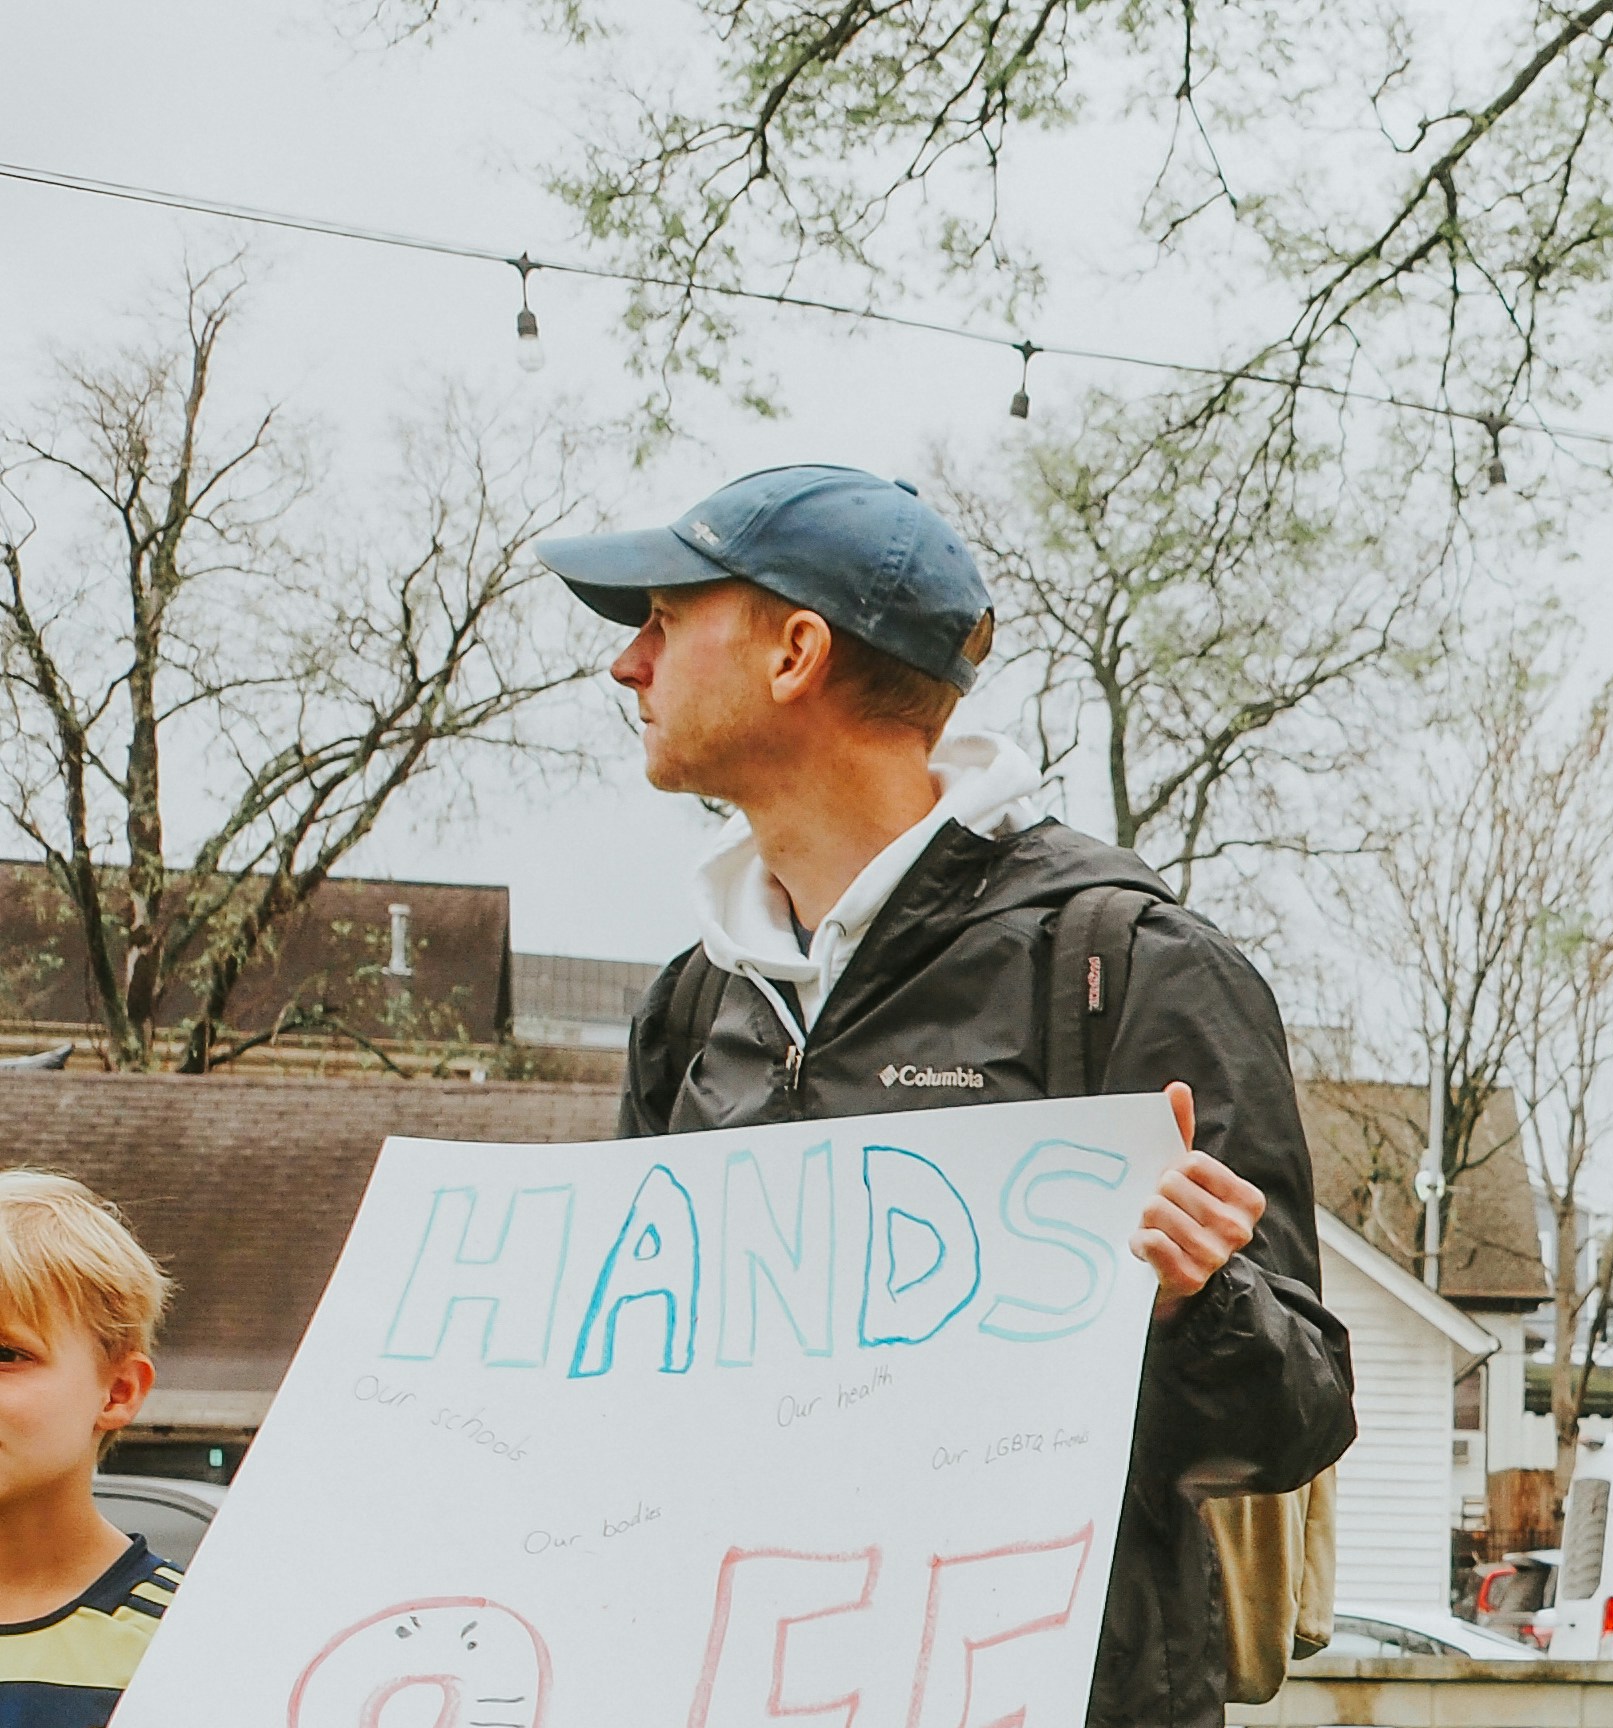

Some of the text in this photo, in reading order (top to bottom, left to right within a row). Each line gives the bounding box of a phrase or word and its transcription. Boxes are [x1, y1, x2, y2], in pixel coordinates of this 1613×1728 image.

[898, 1065, 984, 1088] Columbia
[383, 1138, 1129, 1380] HANDS
[354, 1375, 530, 1461] Our schools
[777, 1364, 893, 1428] Our health
[932, 1446, 968, 1470] Our
[985, 1433, 1045, 1464] LGBTQ
[524, 1501, 663, 1555] Our bodies
